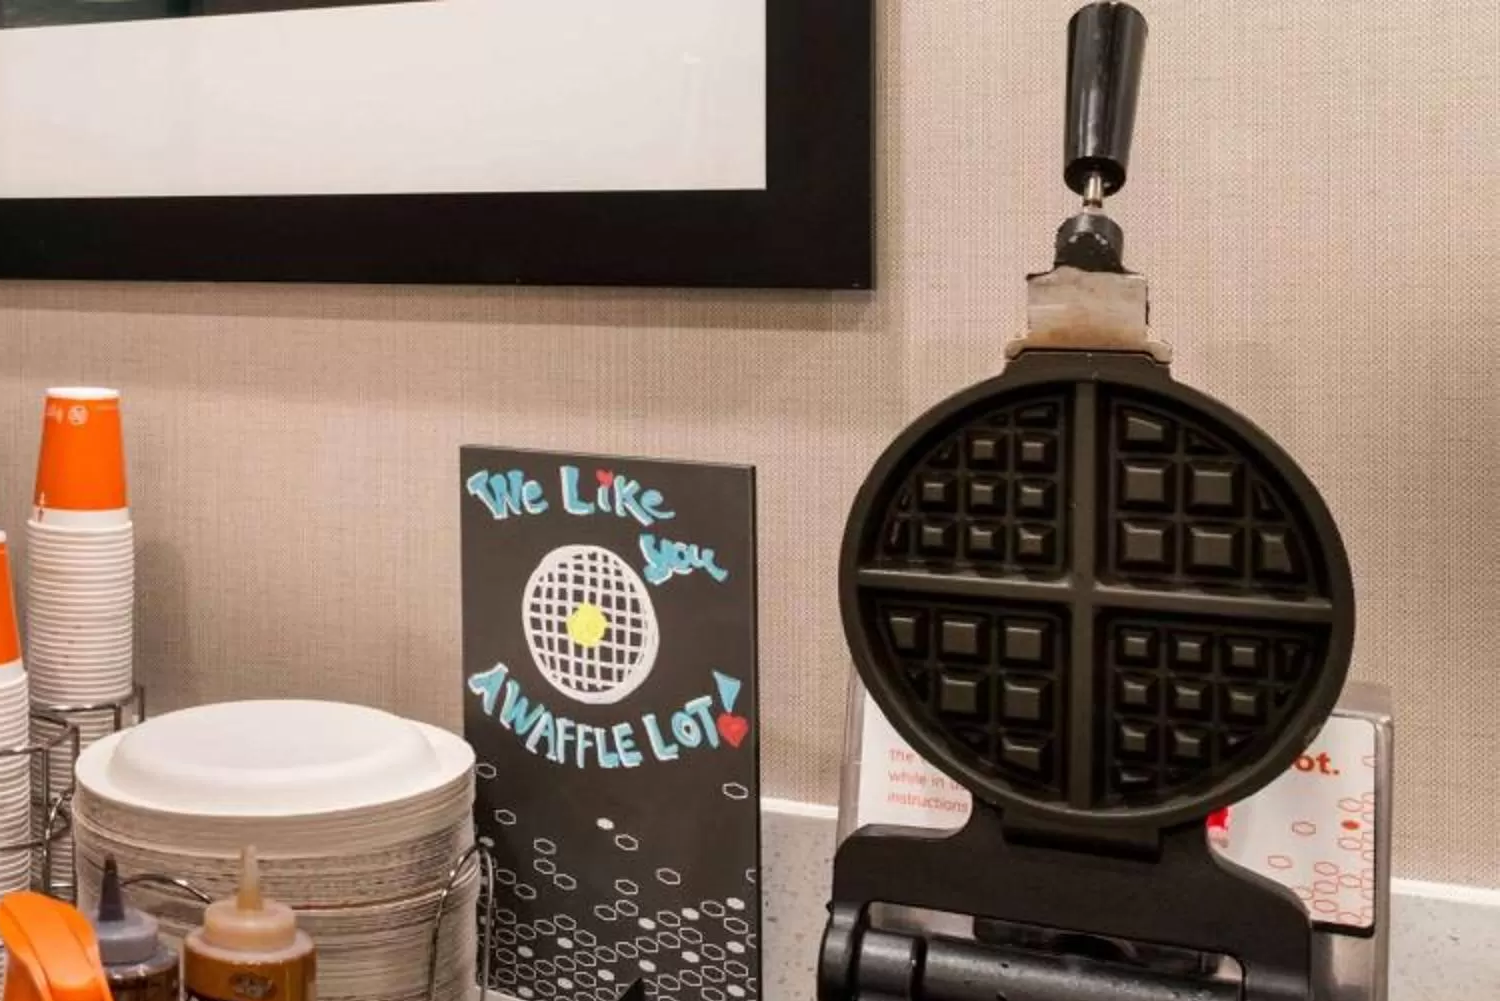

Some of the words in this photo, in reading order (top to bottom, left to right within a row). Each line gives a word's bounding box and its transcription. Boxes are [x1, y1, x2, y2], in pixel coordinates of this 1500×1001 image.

[466, 470, 549, 520] We
[560, 465, 676, 526] Like
[467, 662, 509, 715] A
[500, 680, 643, 768] WAFFLE
[1294, 751, 1341, 776] ot.
